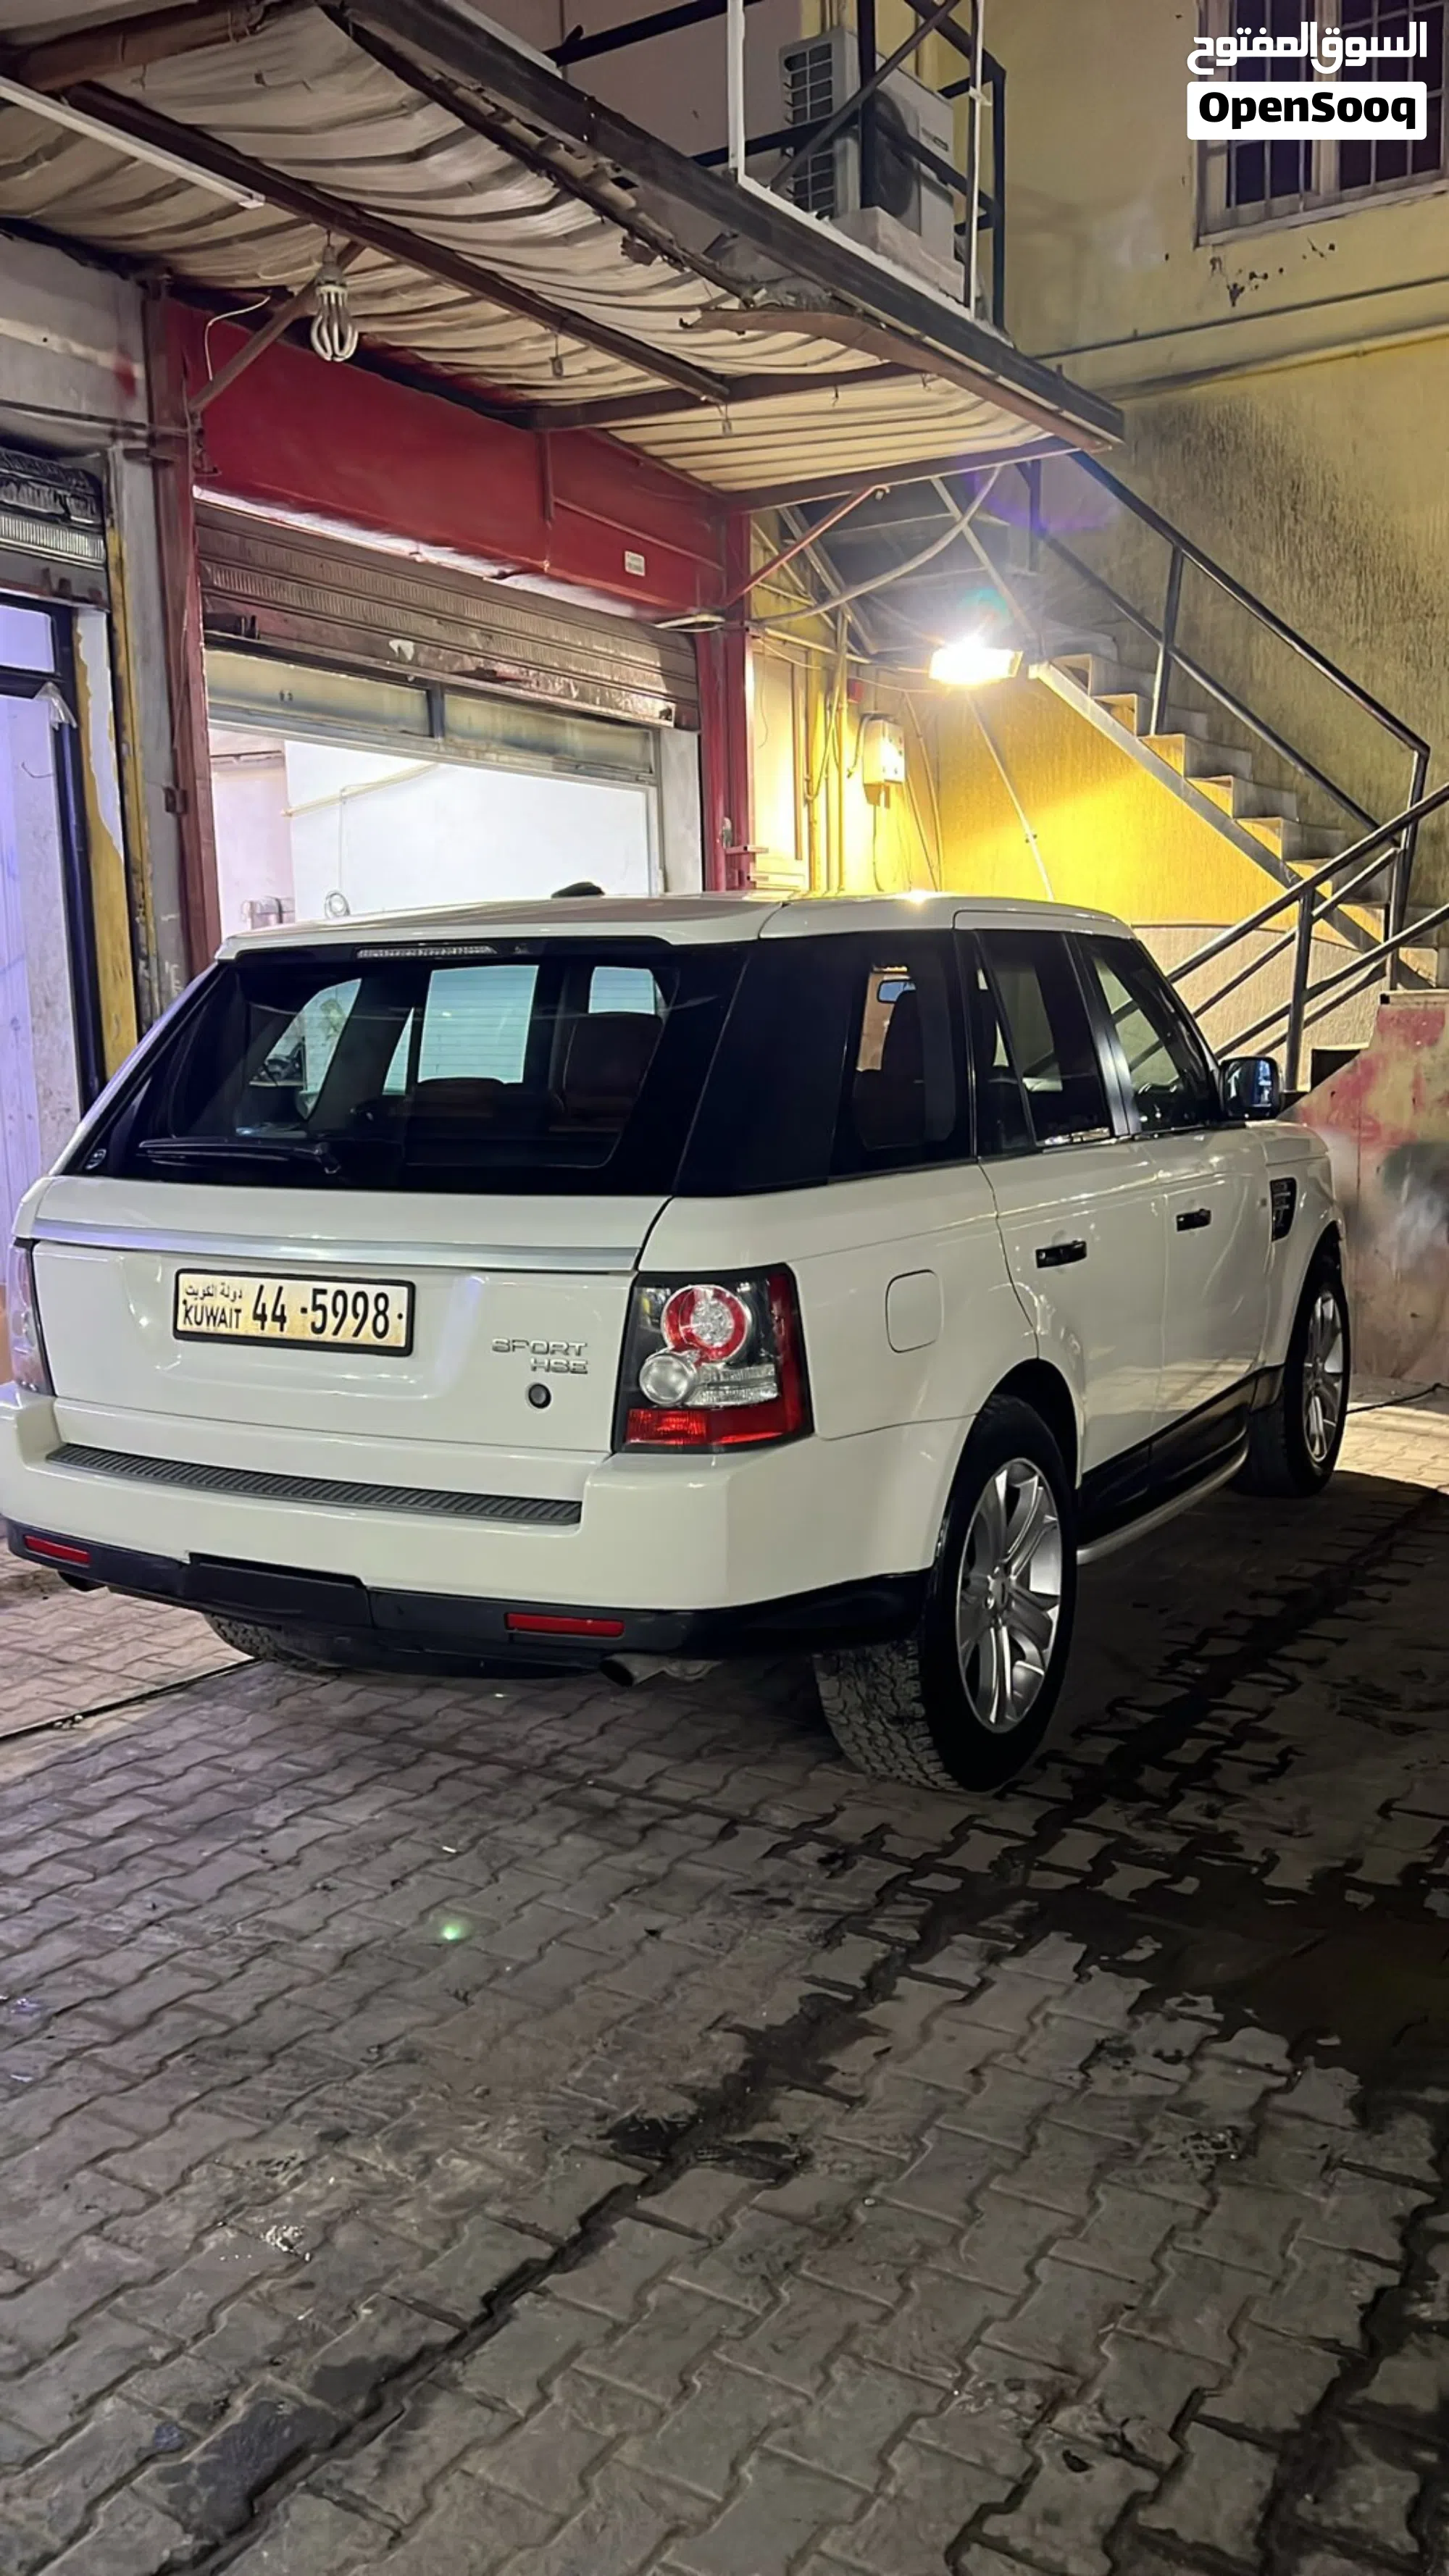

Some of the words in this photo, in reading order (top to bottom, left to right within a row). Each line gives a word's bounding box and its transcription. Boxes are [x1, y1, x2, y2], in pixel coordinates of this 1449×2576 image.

[183, 1304, 242, 1329] KUWAIT
[252, 1284, 287, 1332] 44
[311, 1288, 390, 1339] 5998
[492, 1338, 588, 1356] SPORT
[530, 1357, 588, 1374] HSE
